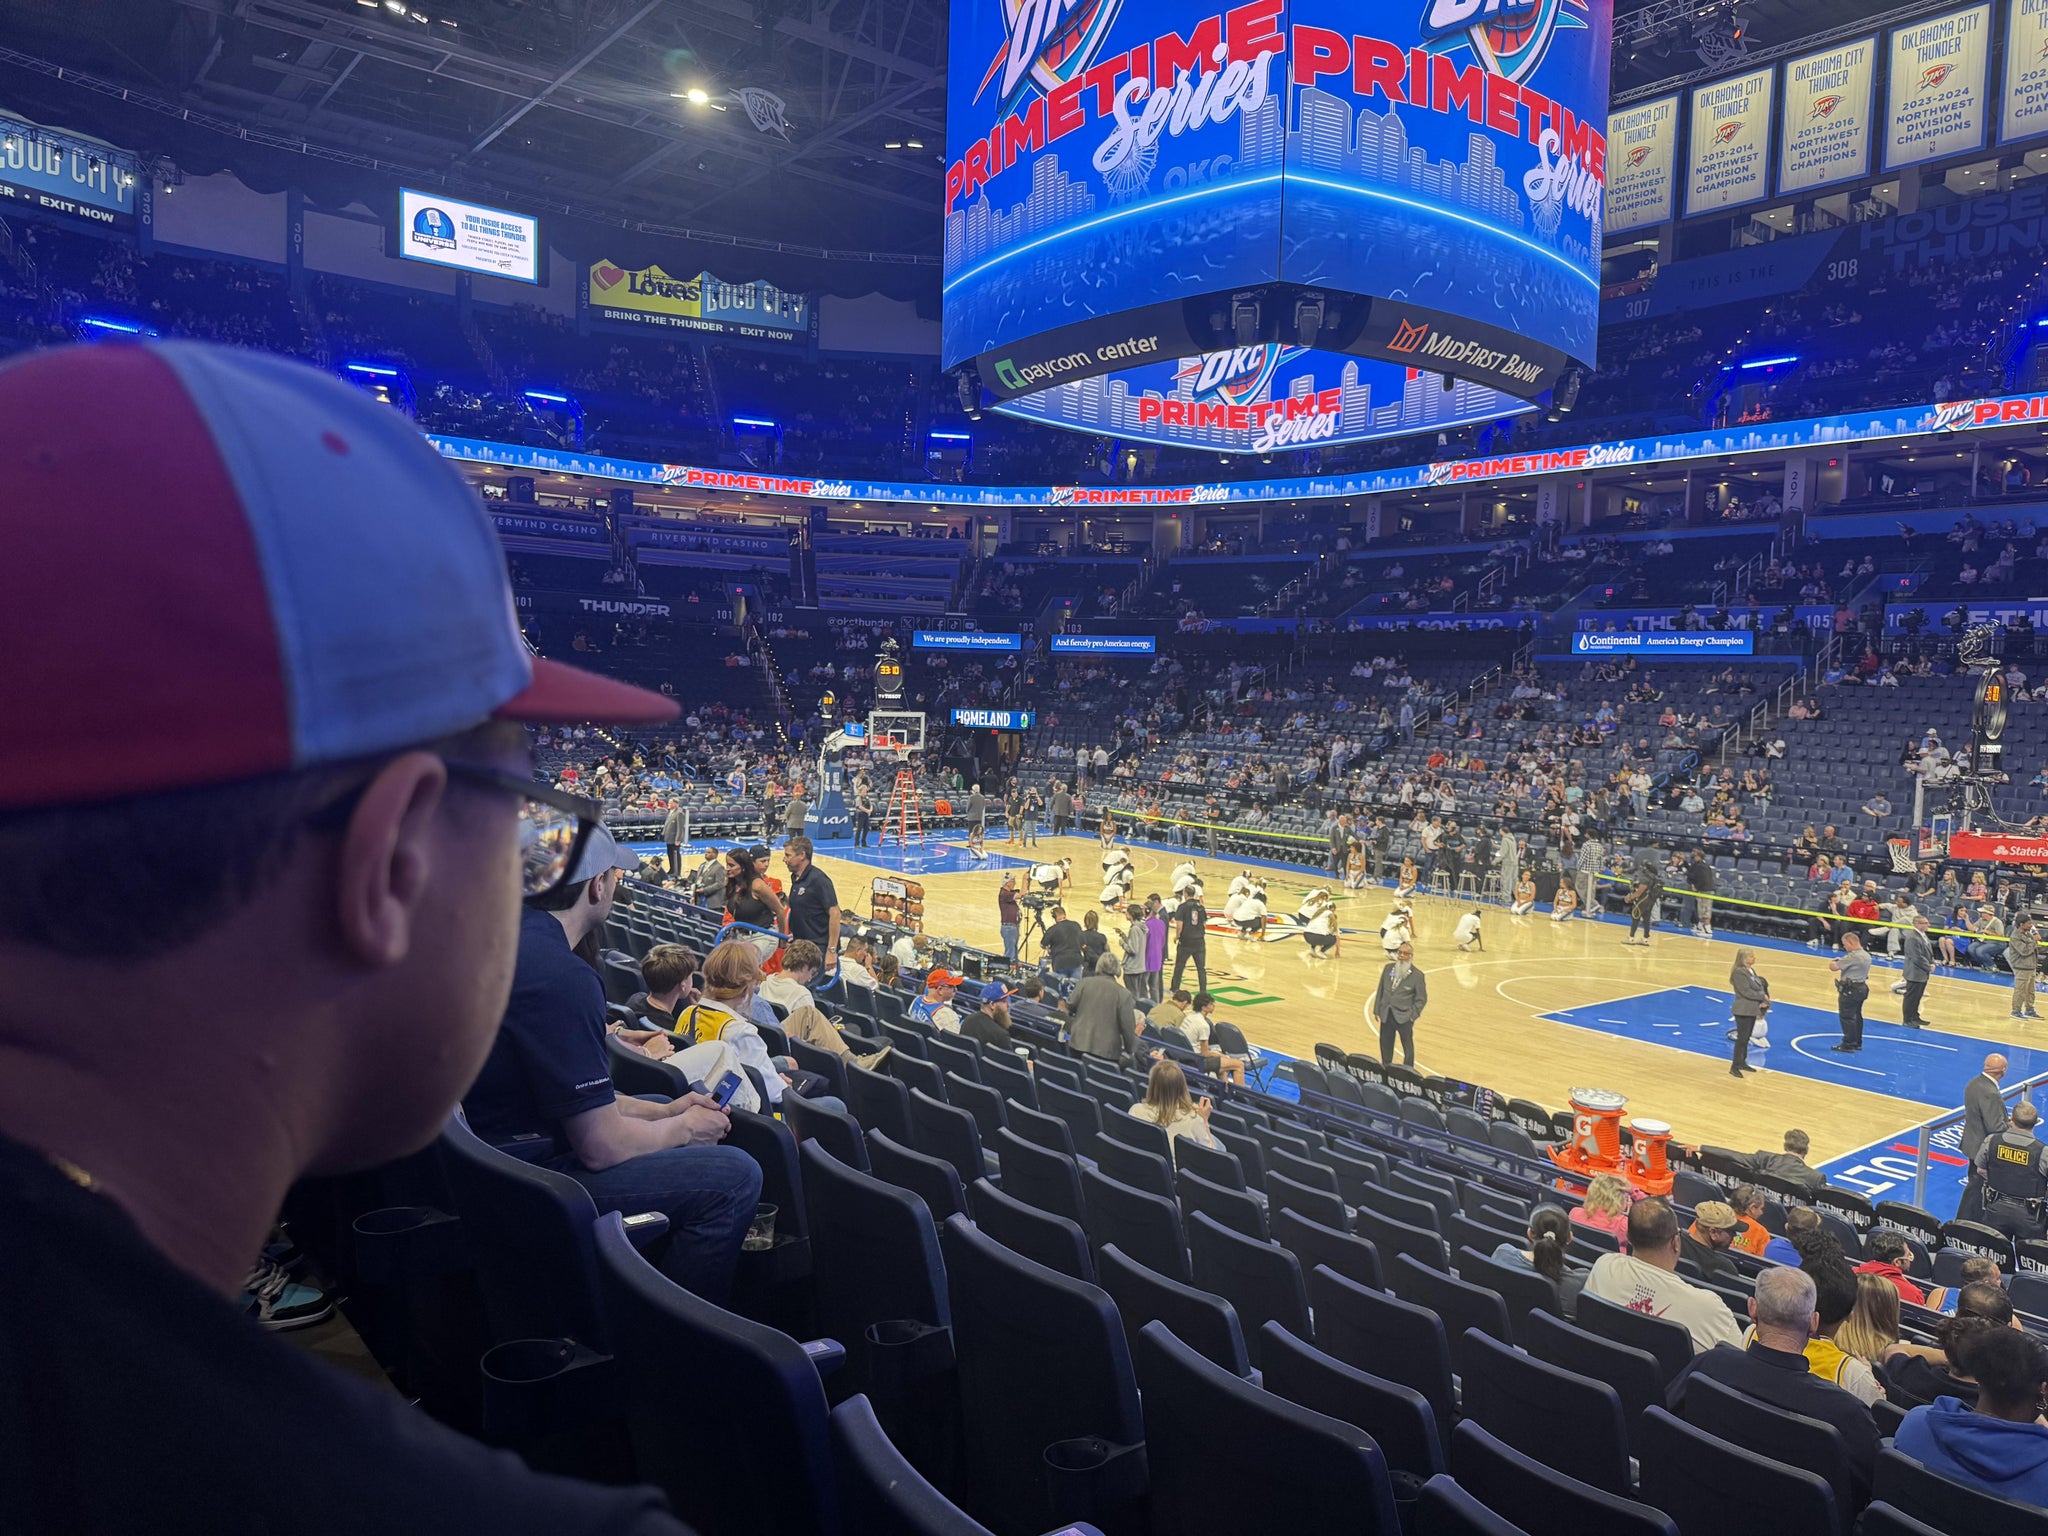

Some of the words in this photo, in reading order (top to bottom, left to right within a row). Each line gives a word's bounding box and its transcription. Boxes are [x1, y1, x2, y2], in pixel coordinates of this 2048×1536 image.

[1901, 20, 1954, 51] OKLAHOMA
[1957, 12, 1979, 34] CITY
[1917, 36, 1961, 64] THUNDER
[1795, 54, 1842, 81] OKLAHOMA
[1845, 47, 1864, 67] CITY
[1700, 83, 1743, 108] OKLAHOMA
[1745, 76, 1763, 96] CITY
[1808, 70, 1848, 95] THUNDER
[945, 0, 1286, 217] PRIMETIME
[1093, 42, 1273, 173] Series
[1292, 24, 1607, 188] PRIMETIME
[1713, 98, 1749, 121] THUNDER
[1902, 87, 1970, 111] 2023-2024
[1613, 110, 1651, 133] OKLAHOMA
[1653, 104, 1670, 120] CITY
[1896, 98, 1974, 124] NORTHWEST
[1907, 111, 1962, 132] DIVISION
[1624, 124, 1657, 145] THUNDER
[1797, 117, 1854, 138] 2015-2016
[1897, 120, 1971, 144] CHAMPIONS
[1790, 128, 1860, 151] NORTHWEST
[1800, 141, 1849, 159] DIVISION
[1696, 152, 1758, 175] NORTHWEST
[1702, 143, 1753, 163] 2013-2014
[1790, 150, 1857, 171] CHAMPIONS
[1614, 168, 1661, 185] 2012-2013
[1696, 173, 1756, 194] CHAMPIONS
[1704, 165, 1749, 182] DIVISION
[1608, 176, 1666, 196] NORTHWEST
[1615, 188, 1657, 203] DIVISION
[40, 195, 76, 214] EXIT
[79, 207, 115, 224] NOW
[1608, 196, 1663, 214] CHAMPIONS
[465, 214, 481, 225] YOUR
[481, 218, 500, 229] INSIDE
[501, 222, 522, 233] ACCESS
[1860, 186, 2048, 250] HOUSE
[461, 222, 469, 231] TO
[469, 223, 479, 233] ALL
[479, 225, 500, 237] THINGS
[501, 230, 526, 242] THUNDER
[1827, 258, 1858, 282] 308
[1625, 299, 1651, 318] 307
[604, 309, 641, 322] BRING
[644, 314, 667, 326] THE
[669, 318, 723, 332] THUNDER
[740, 326, 766, 338] EXIT
[768, 330, 793, 341] NOW
[1020, 351, 1092, 384] paycom
[1096, 334, 1158, 361] center
[1195, 345, 1265, 392] OKC
[1138, 386, 1341, 431] PRIMETIME
[1932, 401, 1975, 430] OKC
[1253, 404, 1336, 451] Series
[1451, 449, 1589, 481] PRIMETIME
[1581, 441, 1635, 467] Series
[687, 470, 814, 494] PRIMETIME
[809, 480, 852, 497] Series
[1073, 488, 1194, 504] PRIMETIME
[1189, 484, 1230, 503] Series
[552, 523, 598, 535] CASINO
[652, 532, 719, 546] RIVERWIND
[725, 538, 768, 549] CASINO
[580, 599, 670, 617] THUNDER
[717, 610, 732, 620] 101
[767, 612, 784, 623] 102
[827, 617, 895, 628] @okcthunder
[1067, 623, 1082, 633] 103
[1806, 614, 1830, 628] 105
[922, 634, 934, 643] We
[946, 634, 970, 646] proudly
[971, 636, 1011, 647] independent.
[1056, 638, 1069, 647] And
[1070, 638, 1091, 649] fiercely
[1092, 641, 1103, 649] pro
[1104, 639, 1129, 648] American
[1131, 641, 1151, 650] energy.
[1590, 634, 1641, 646] Continental
[1646, 637, 1679, 646] America's
[1680, 637, 1704, 648] Energy
[1706, 637, 1744, 647] Champion
[956, 710, 1011, 727] HOMELAND
[1575, 1115, 1592, 1136] G
[1634, 1139, 1647, 1155] G
[1999, 1146, 2028, 1163] POLICE
[1878, 1215, 1894, 1230] GET
[1894, 1221, 1910, 1235] THE
[1945, 1236, 1961, 1250] GET
[1961, 1241, 1977, 1256] THE
[2021, 1255, 2036, 1272] GET
